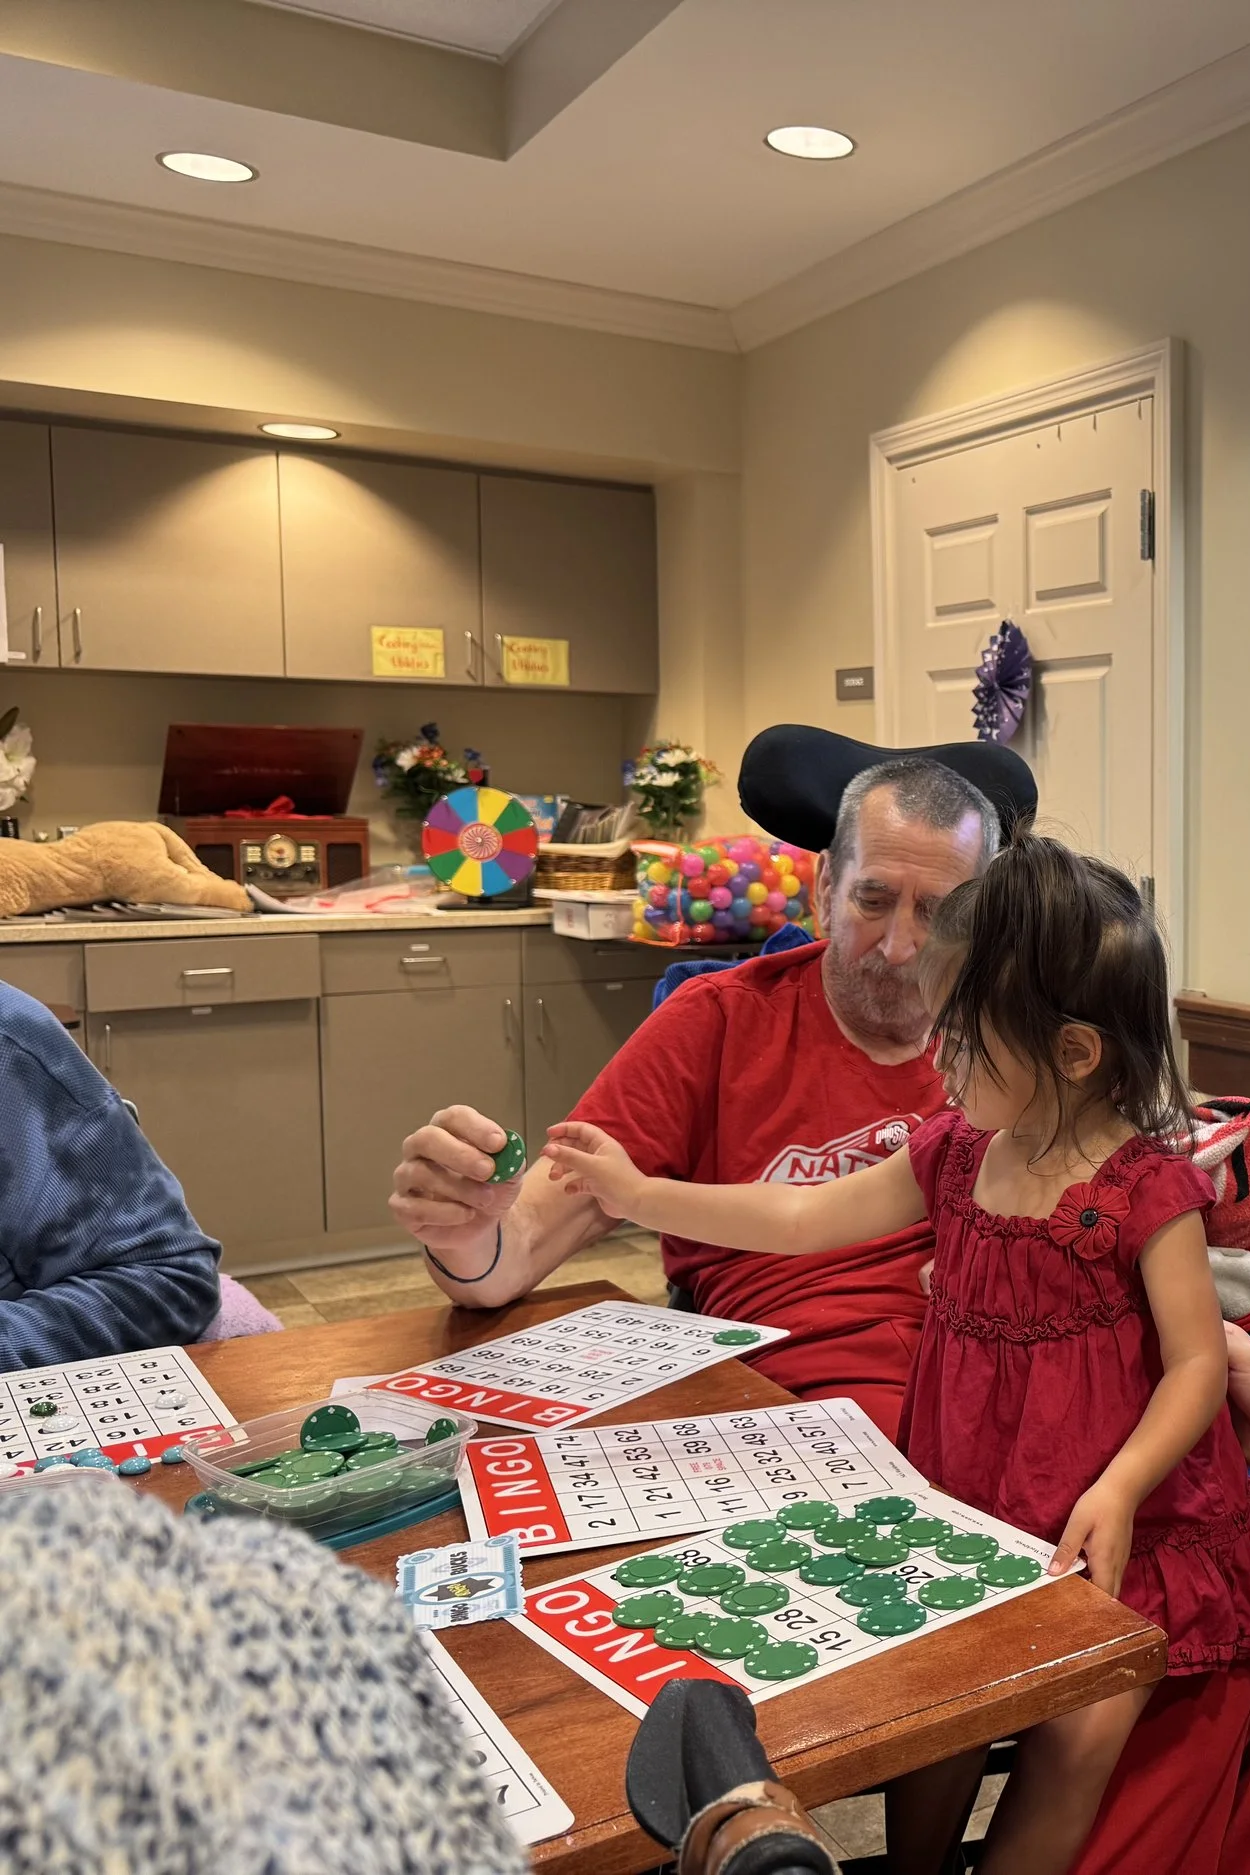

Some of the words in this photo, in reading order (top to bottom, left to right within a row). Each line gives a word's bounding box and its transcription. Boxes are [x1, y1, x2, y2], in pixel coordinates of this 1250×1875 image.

[582, 1312, 612, 1320] 72
[615, 1318, 645, 1326] 49
[548, 1324, 578, 1333] 61
[650, 1323, 680, 1332] 38
[684, 1329, 715, 1338] 23
[580, 1330, 612, 1339] 55
[512, 1337, 542, 1346] 69
[544, 1342, 577, 1352] 52
[613, 1336, 648, 1346] 37
[650, 1342, 679, 1351] 16
[472, 1350, 504, 1360] 66
[613, 1356, 649, 1366] 27
[140, 1362, 158, 1370] 8
[506, 1356, 540, 1367] 56
[658, 1362, 678, 1371] 9
[75, 1368, 114, 1380] 23
[432, 1363, 466, 1374] 68
[541, 1364, 574, 1373] 45
[139, 1374, 176, 1384] 13
[466, 1370, 500, 1380] 47
[578, 1370, 612, 1380] 28
[621, 1376, 643, 1386] 2
[18, 1378, 57, 1390] 33
[82, 1382, 122, 1394] 28
[504, 1378, 536, 1388] 43
[540, 1384, 571, 1394] 18
[24, 1392, 64, 1405] 34
[386, 1376, 578, 1422] BINGO
[582, 1392, 604, 1401] 5
[90, 1397, 130, 1409] 18
[98, 1412, 138, 1424] 19
[178, 1417, 197, 1426] 3
[786, 1410, 813, 1422] 71
[672, 1422, 700, 1436] 68
[730, 1416, 758, 1430] 63
[106, 1427, 148, 1440] 16
[614, 1429, 642, 1443] 62
[796, 1425, 826, 1439] 57
[44, 1438, 88, 1452] 42
[554, 1436, 582, 1448] 74
[742, 1432, 768, 1446] 49
[683, 1440, 712, 1454] 59
[811, 1441, 839, 1456] 40
[2, 1450, 24, 1459] 4
[624, 1446, 652, 1462] 53
[753, 1449, 782, 1464] 32
[562, 1454, 590, 1468] 47
[825, 1458, 856, 1474] 20
[632, 1465, 660, 1480] 42
[766, 1468, 796, 1484] 25
[569, 1472, 599, 1488] 34
[705, 1477, 735, 1492] 16
[842, 1482, 868, 1490] 7
[480, 1442, 557, 1545] BINGO
[643, 1486, 673, 1502] 21
[577, 1494, 608, 1509] 17
[718, 1498, 748, 1514] 11
[588, 1518, 616, 1528] 2
[450, 1551, 468, 1576] BUCKS
[673, 1549, 712, 1568] 68
[891, 1564, 934, 1586] 26
[774, 1608, 818, 1630] 28
[536, 1590, 688, 1682] INGO
[810, 1630, 852, 1651] 15
